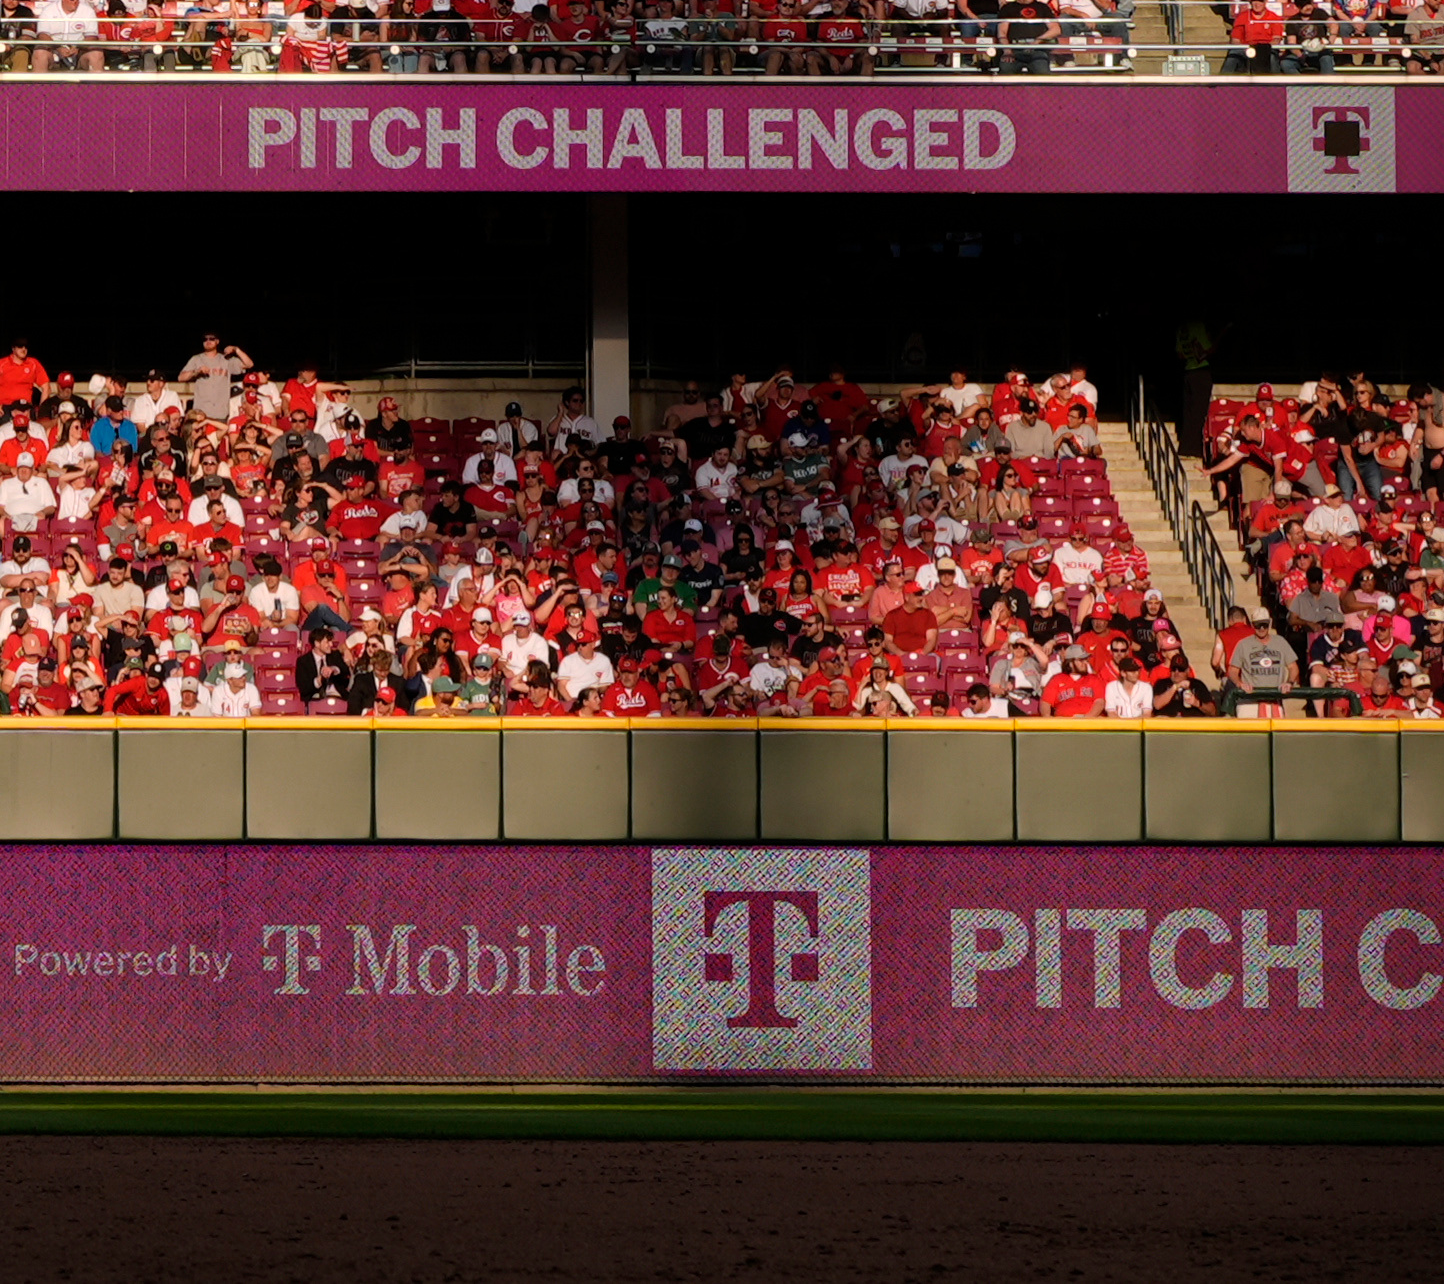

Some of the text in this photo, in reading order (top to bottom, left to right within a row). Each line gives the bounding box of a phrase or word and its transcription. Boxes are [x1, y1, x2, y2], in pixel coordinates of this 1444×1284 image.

[249, 106, 1017, 171] PITCH CHALLENGED
[344, 506, 378, 520] Reds
[616, 690, 646, 706] Reds
[14, 945, 179, 978] Powered
[189, 945, 231, 983] by
[346, 924, 605, 996] Mobile
[950, 908, 1323, 1009] PITCH
